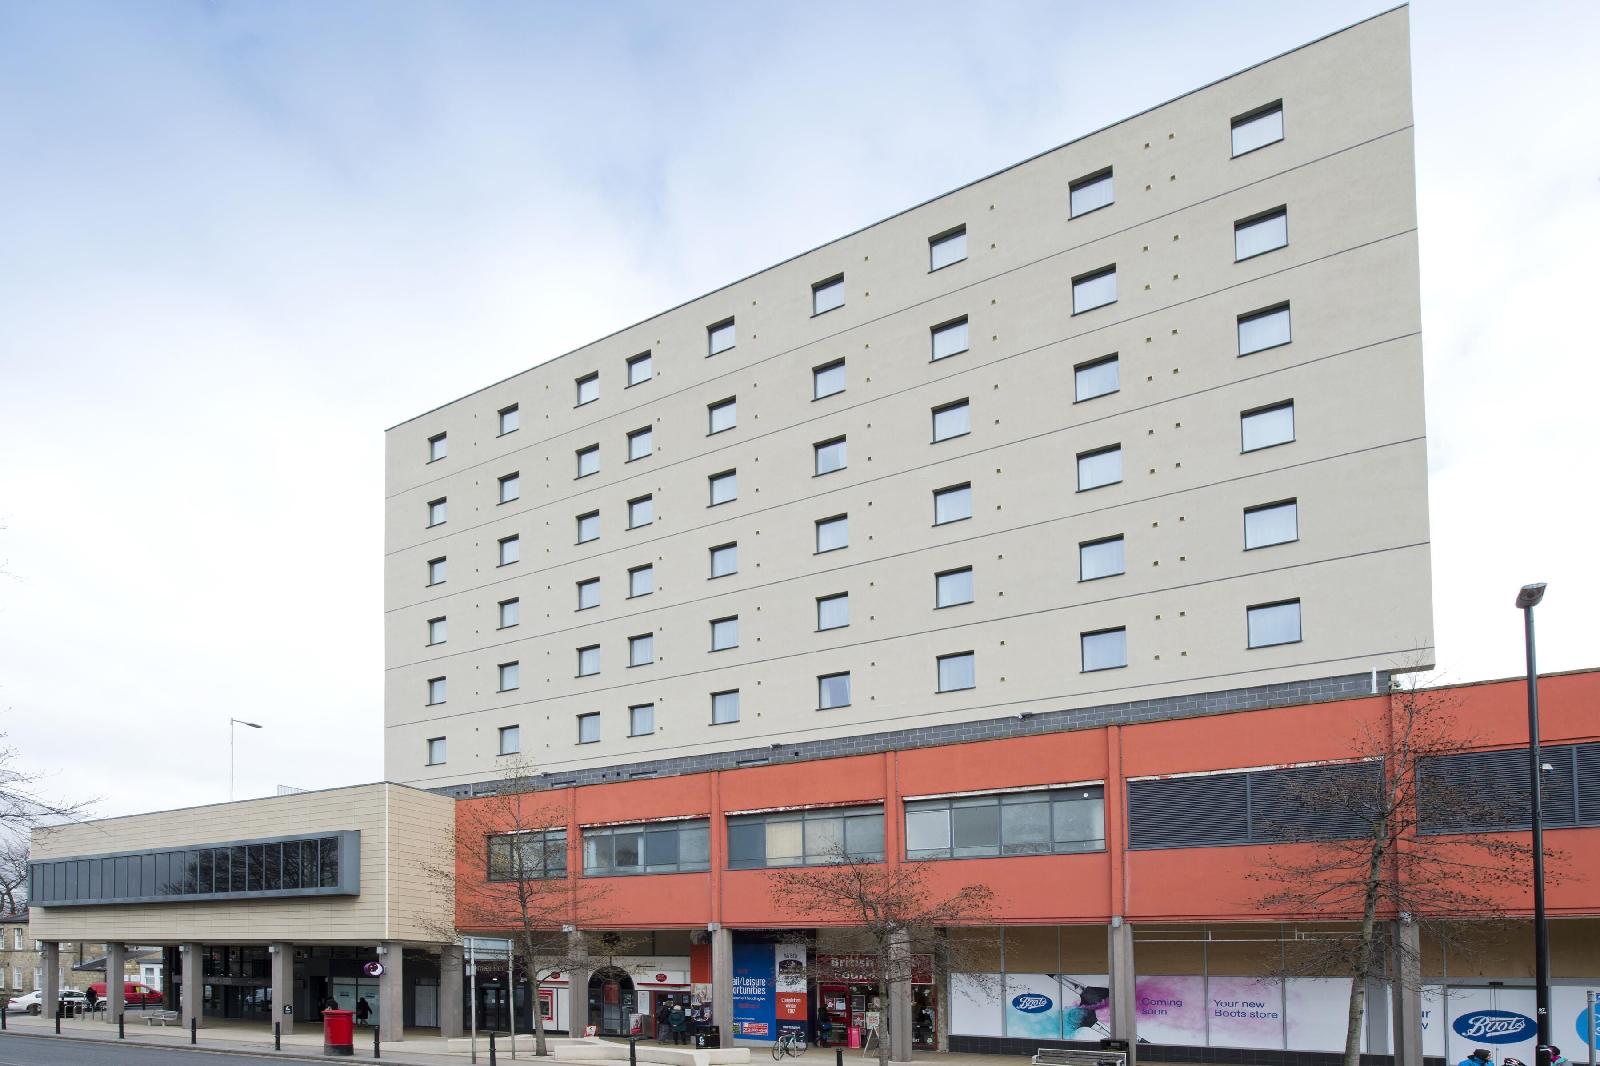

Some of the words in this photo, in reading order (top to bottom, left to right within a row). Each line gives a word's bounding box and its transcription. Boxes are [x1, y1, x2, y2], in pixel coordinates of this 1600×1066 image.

[732, 976, 767, 987] ail/Leisure
[732, 985, 766, 995] ortunities
[1015, 996, 1048, 1010] Boots
[1141, 997, 1183, 1008] Coming
[1213, 999, 1239, 1008] Your
[1241, 1001, 1265, 1009] new
[1141, 1008, 1168, 1016] soon
[1214, 1009, 1247, 1018] Boots
[1249, 1010, 1279, 1020] store
[1462, 1015, 1526, 1038] Boots
